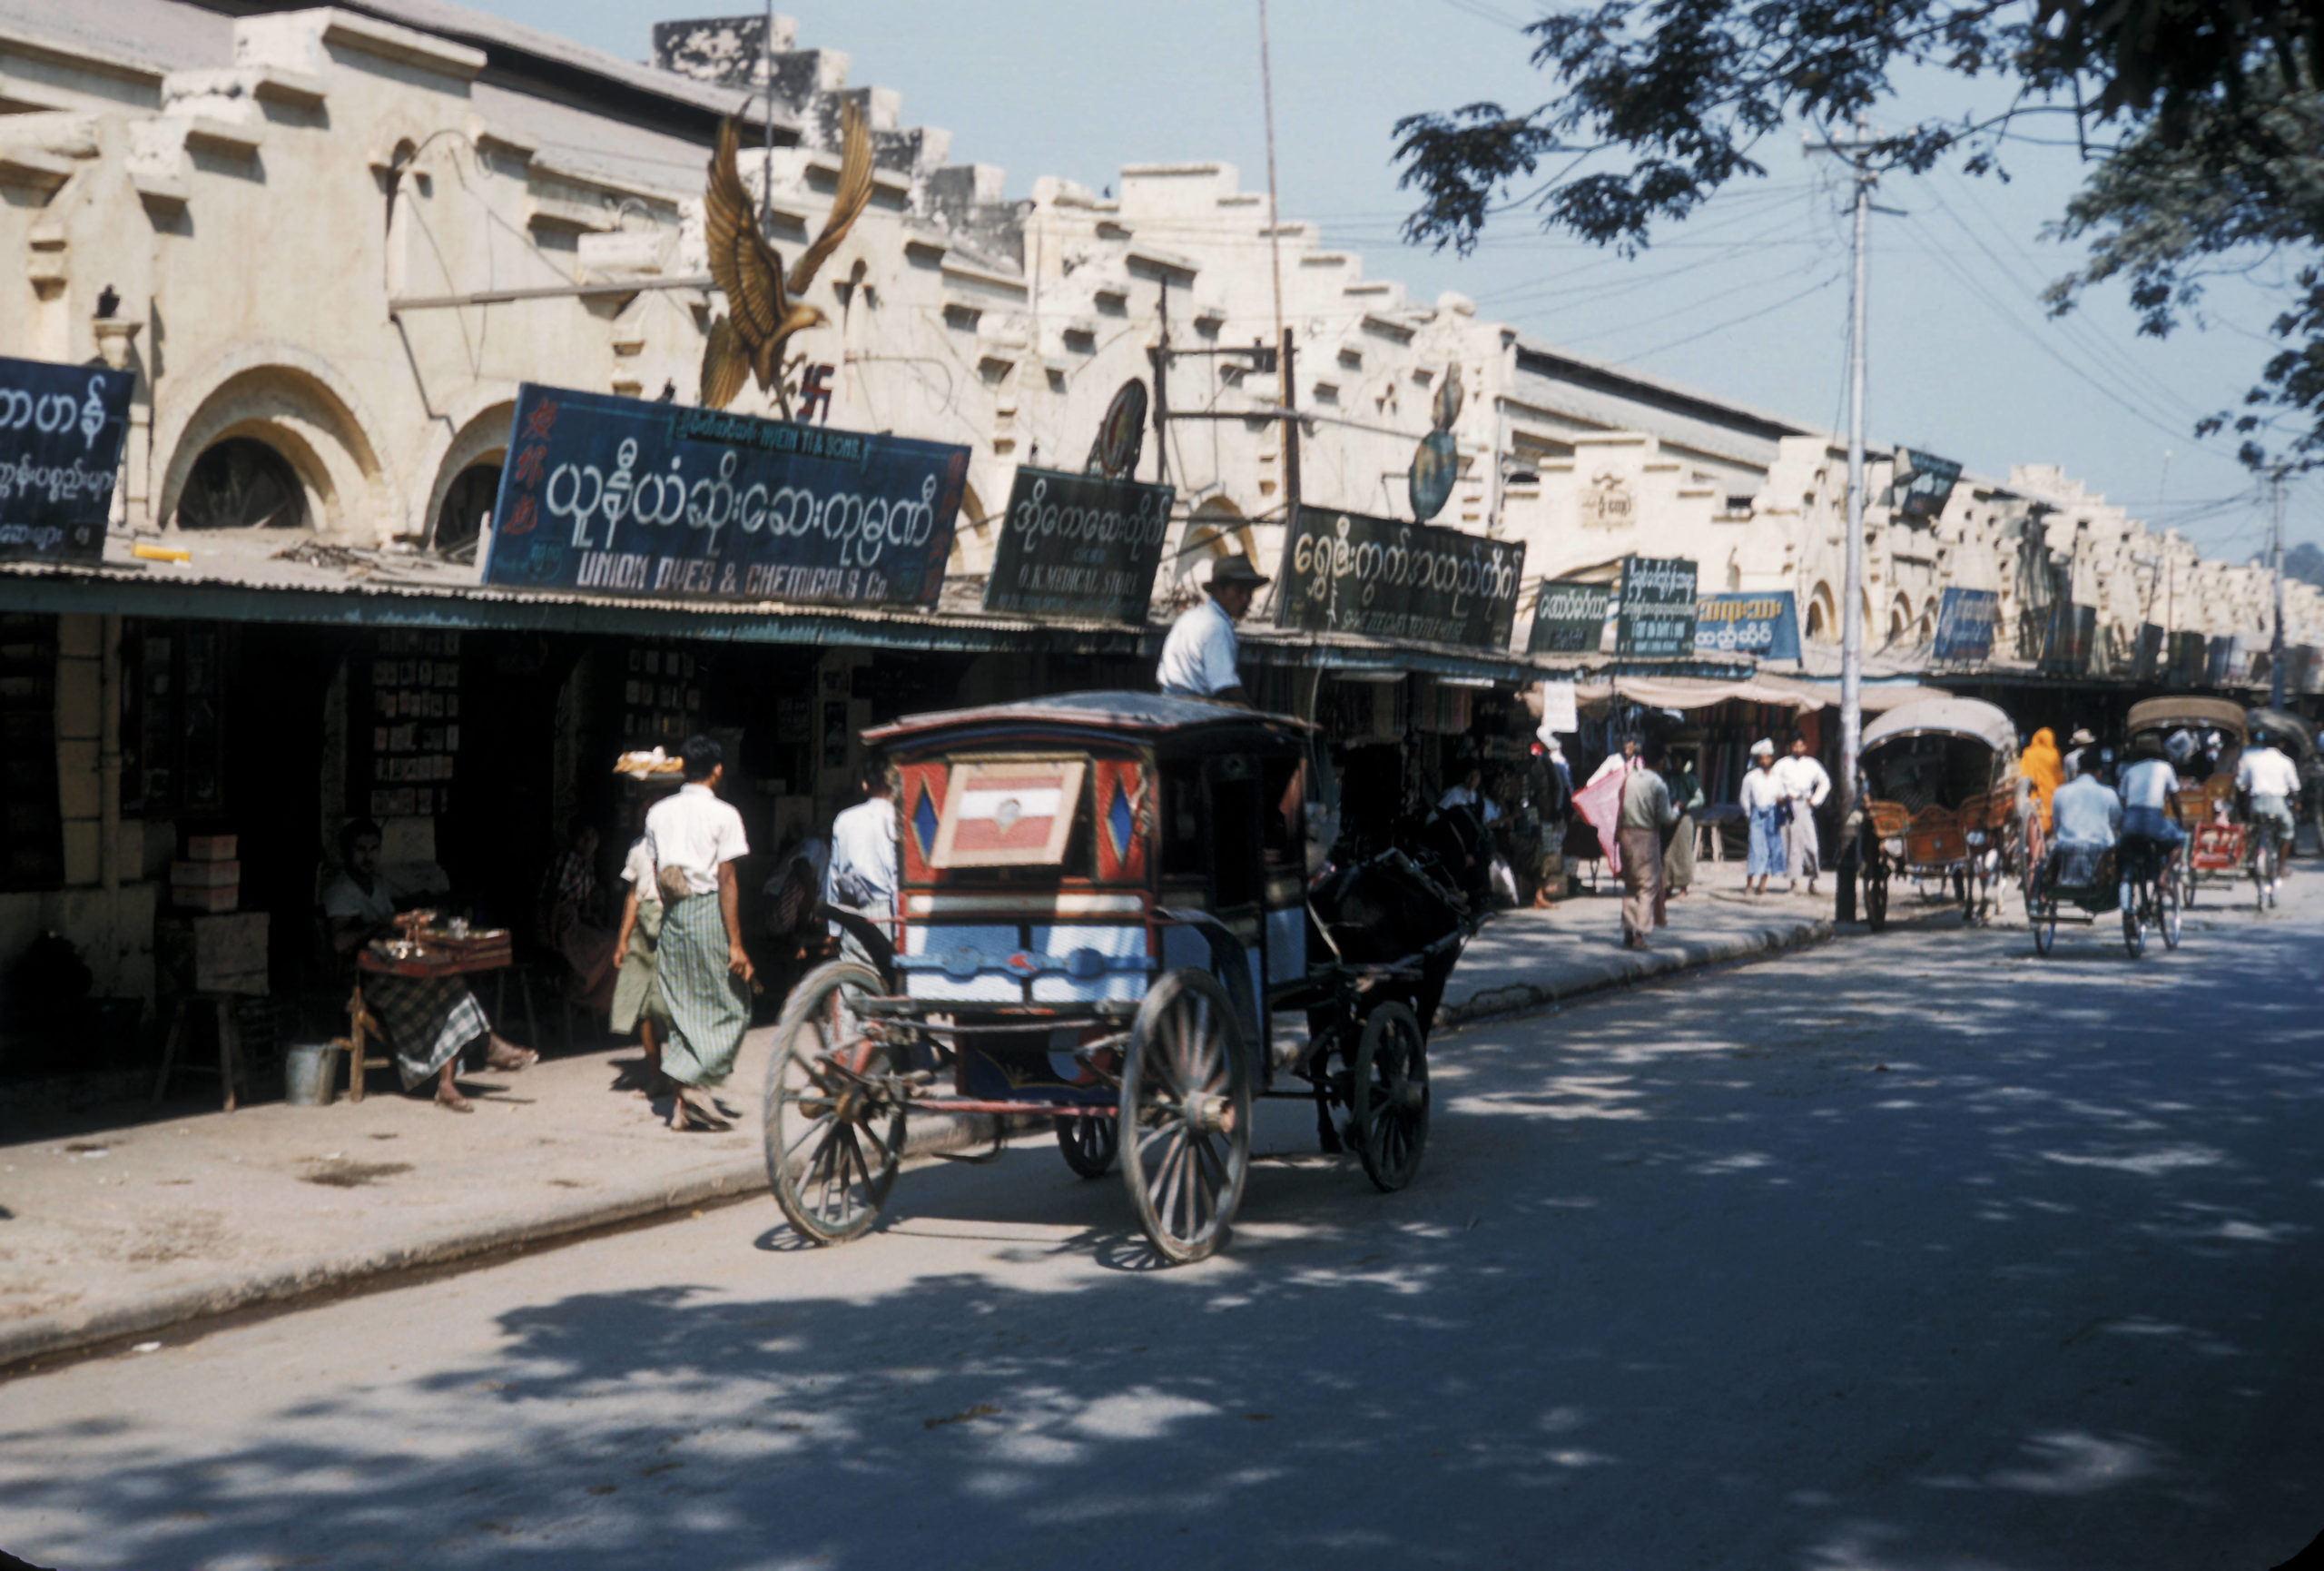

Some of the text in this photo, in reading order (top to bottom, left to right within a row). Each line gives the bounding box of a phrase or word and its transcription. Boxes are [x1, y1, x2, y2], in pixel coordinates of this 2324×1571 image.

[576, 551, 648, 590] UNION
[655, 558, 713, 594] DYES
[719, 561, 736, 596] &
[744, 564, 862, 600] CHEMICALS
